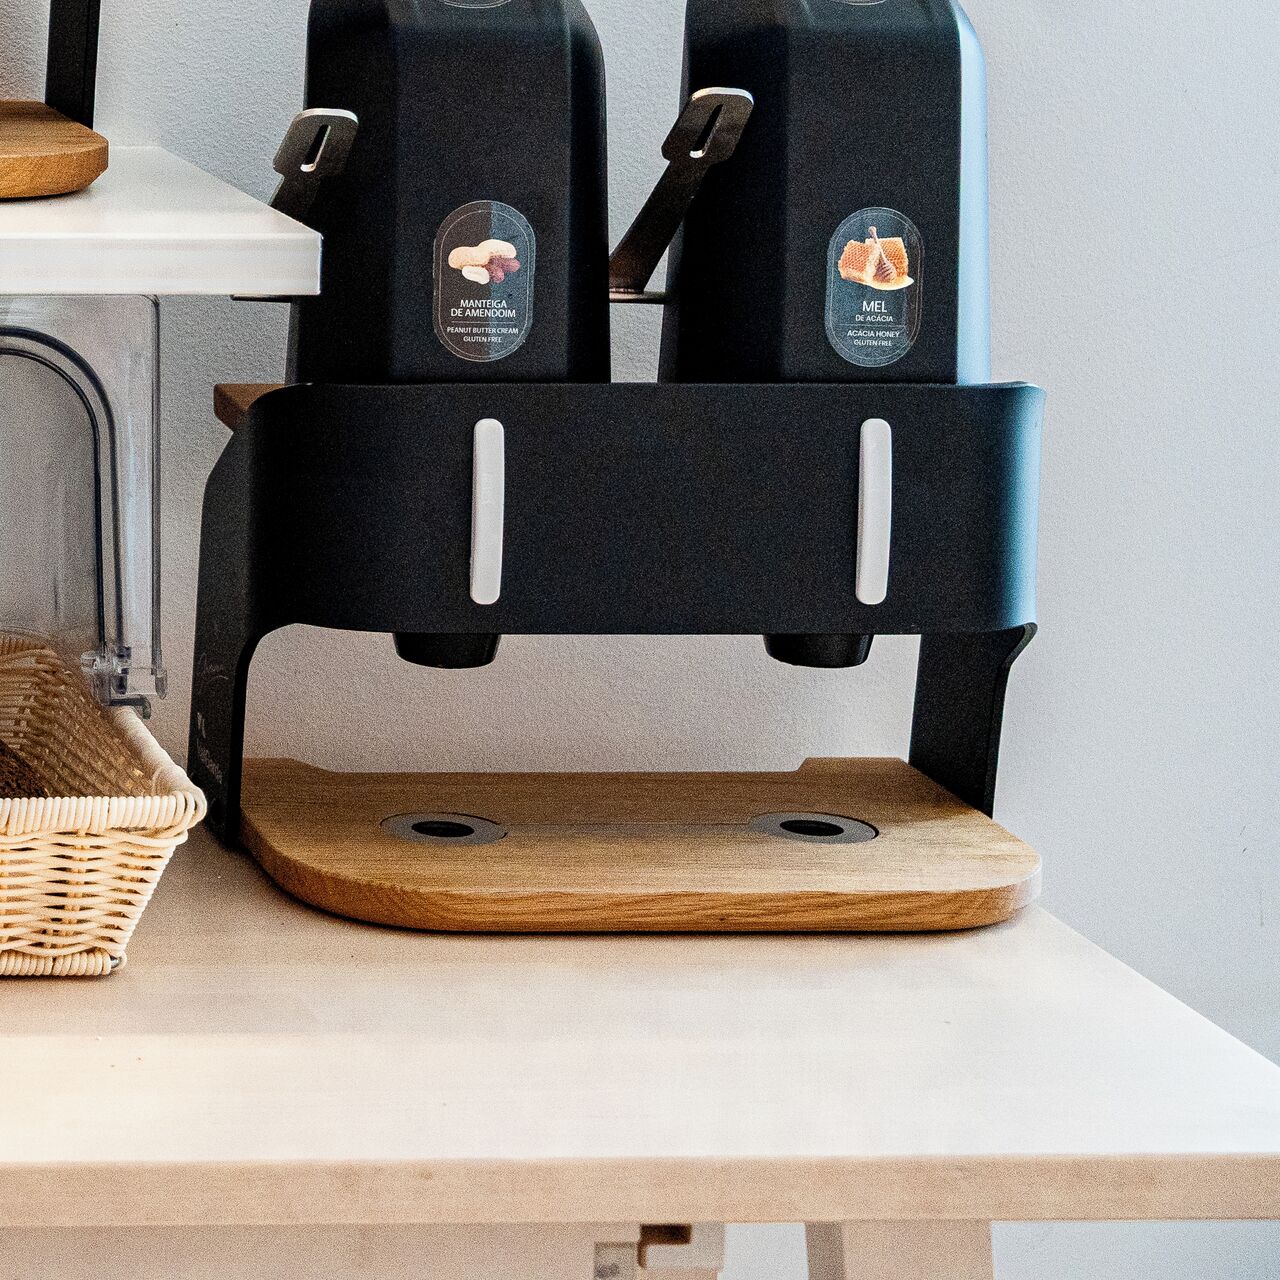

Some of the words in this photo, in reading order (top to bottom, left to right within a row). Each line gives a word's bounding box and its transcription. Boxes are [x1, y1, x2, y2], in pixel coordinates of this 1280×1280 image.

[460, 299, 508, 309] MANTEIGA
[862, 300, 888, 313] MEL
[450, 308, 463, 317] DE
[465, 308, 516, 318] AMENDOIM
[866, 314, 894, 322] ACÁCIA
[446, 326, 472, 334] PEANUT
[496, 327, 519, 335] CREAM
[875, 330, 900, 338] HONEY
